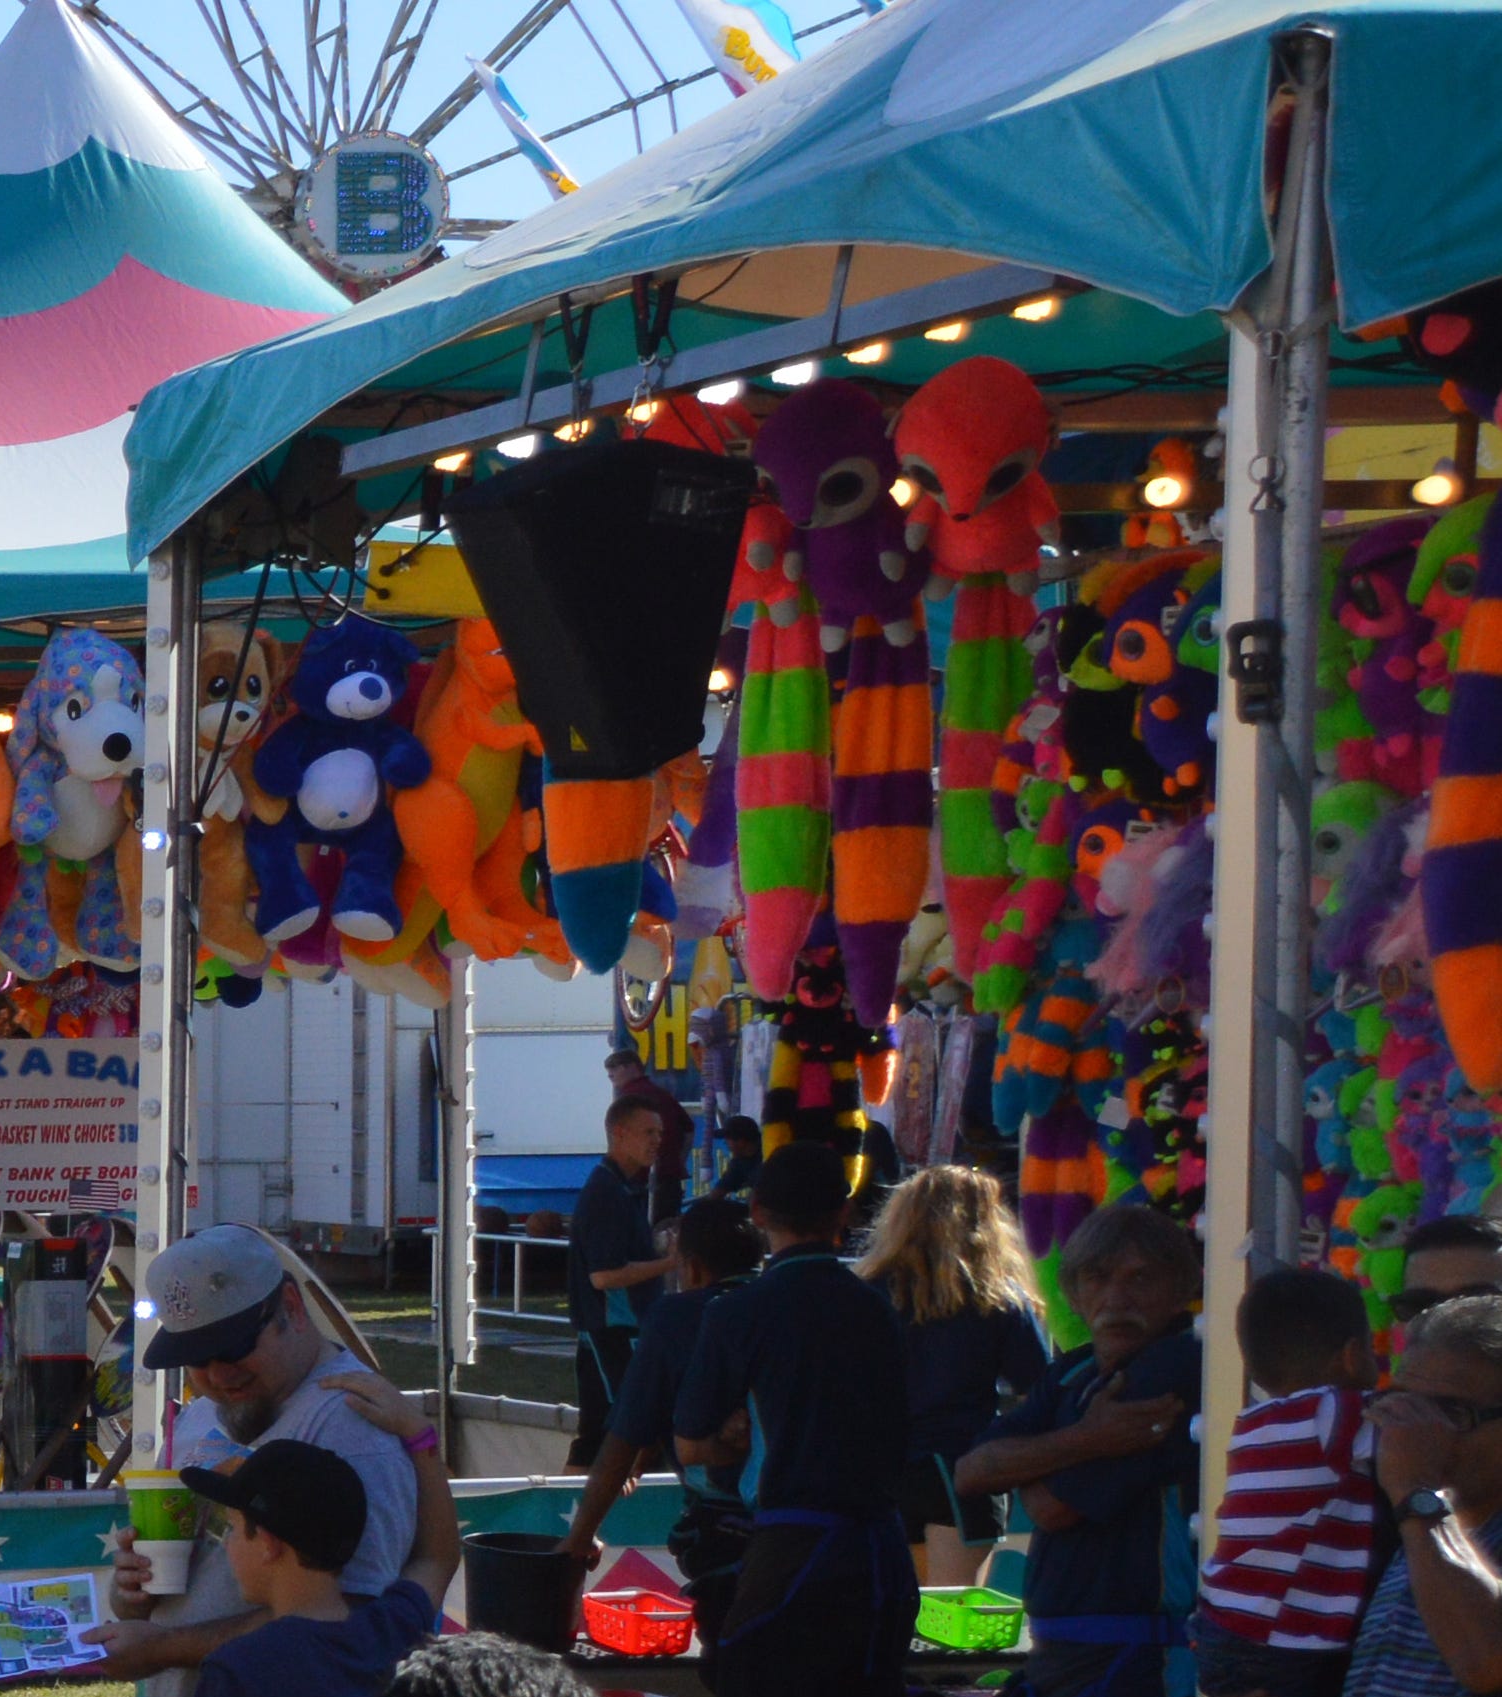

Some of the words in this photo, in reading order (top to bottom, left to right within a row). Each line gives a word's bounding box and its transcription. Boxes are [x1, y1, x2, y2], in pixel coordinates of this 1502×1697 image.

[336, 151, 434, 254] B
[18, 1047, 53, 1077] A
[66, 1049, 139, 1090] BA
[14, 1099, 50, 1110] STAND
[52, 1097, 108, 1110] STRAIGHT
[109, 1097, 126, 1108] UP
[40, 1124, 71, 1144] WINS
[74, 1123, 116, 1144] CHOICE
[7, 1167, 56, 1182] BANK
[60, 1166, 92, 1180] OFF
[5, 1189, 70, 1204] TOUCHI
